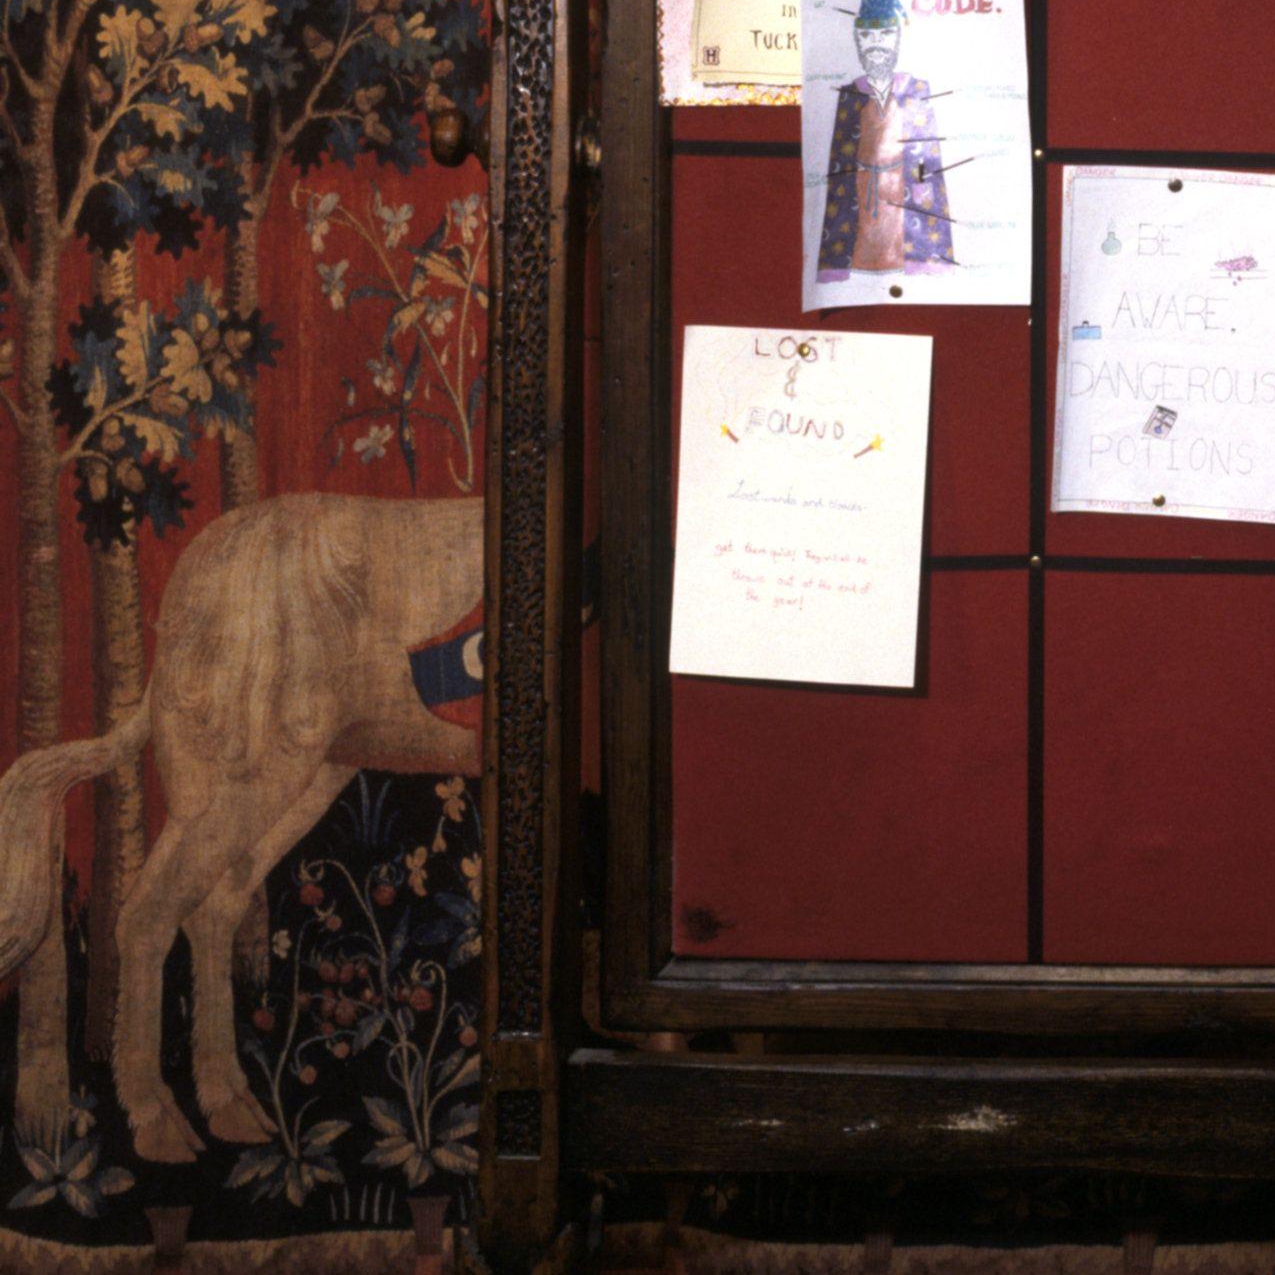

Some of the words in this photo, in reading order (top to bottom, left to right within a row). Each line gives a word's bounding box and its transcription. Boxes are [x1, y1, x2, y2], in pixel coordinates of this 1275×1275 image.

[749, 29, 799, 51] TUCK
[1137, 223, 1184, 256] BE
[748, 407, 845, 440] FOUND
[1088, 434, 1255, 476] POTIONS
[802, 497, 824, 508] and
[713, 538, 734, 558] get
[776, 575, 795, 587] out
